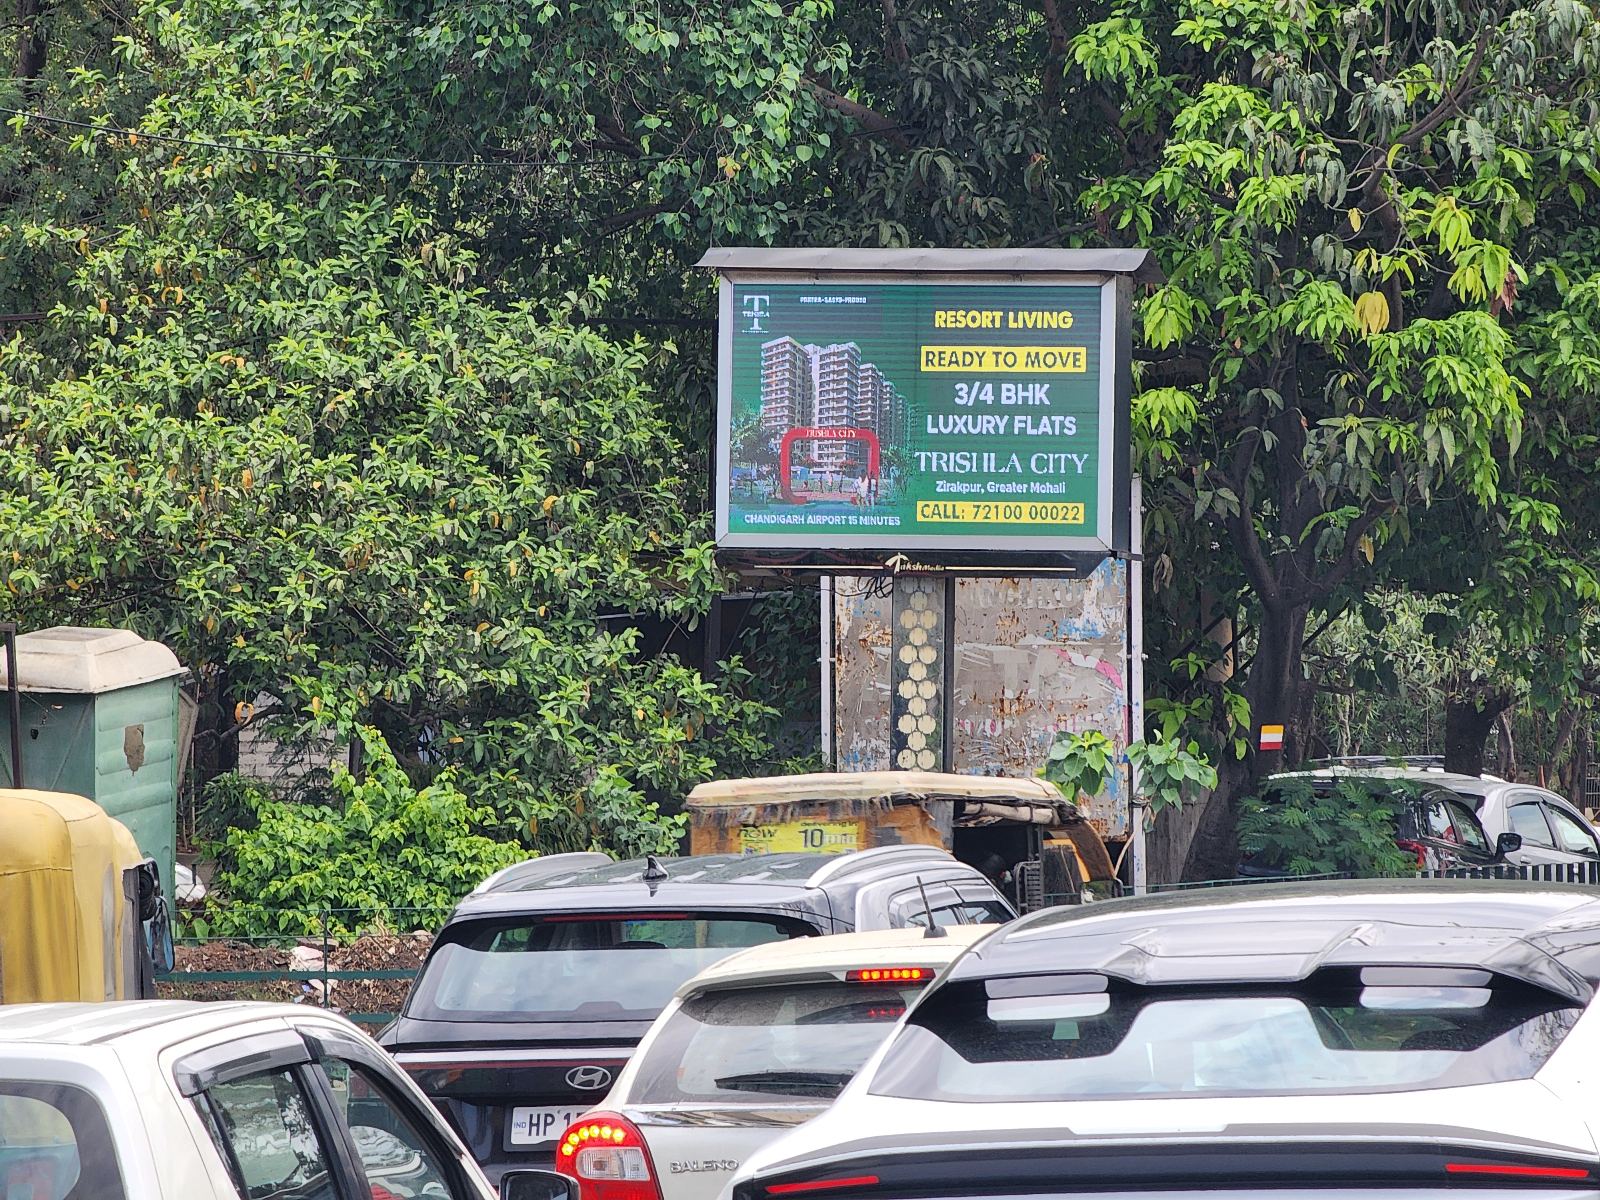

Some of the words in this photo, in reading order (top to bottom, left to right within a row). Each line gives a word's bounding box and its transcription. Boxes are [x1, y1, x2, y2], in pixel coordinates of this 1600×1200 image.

[935, 310, 1003, 329] RESORT
[1008, 310, 1074, 329] LIVING
[925, 350, 987, 368] READY
[992, 351, 1018, 368] TO
[1024, 351, 1082, 369] MOVE
[954, 381, 995, 406] 3/4
[1001, 383, 1051, 405] BHK
[926, 414, 1009, 435] LUXURY
[1013, 415, 1077, 436] FLATS
[1030, 453, 1089, 475] CITY
[935, 480, 985, 494] Zirakpur,
[986, 481, 1028, 494] Greater
[1029, 481, 1066, 494] Mohali
[744, 514, 805, 524] CHANDIGARH
[806, 515, 846, 525] AIRPORT
[847, 516, 858, 525] 15
[859, 516, 901, 526] MINUTES
[920, 503, 965, 520] CALL:
[972, 504, 1021, 520] 72100
[1029, 505, 1080, 521] 00022
[798, 828, 824, 848] 10
[513, 1121, 527, 1129] IND
[528, 1113, 556, 1137] HP
[670, 1159, 740, 1174] BALENO
